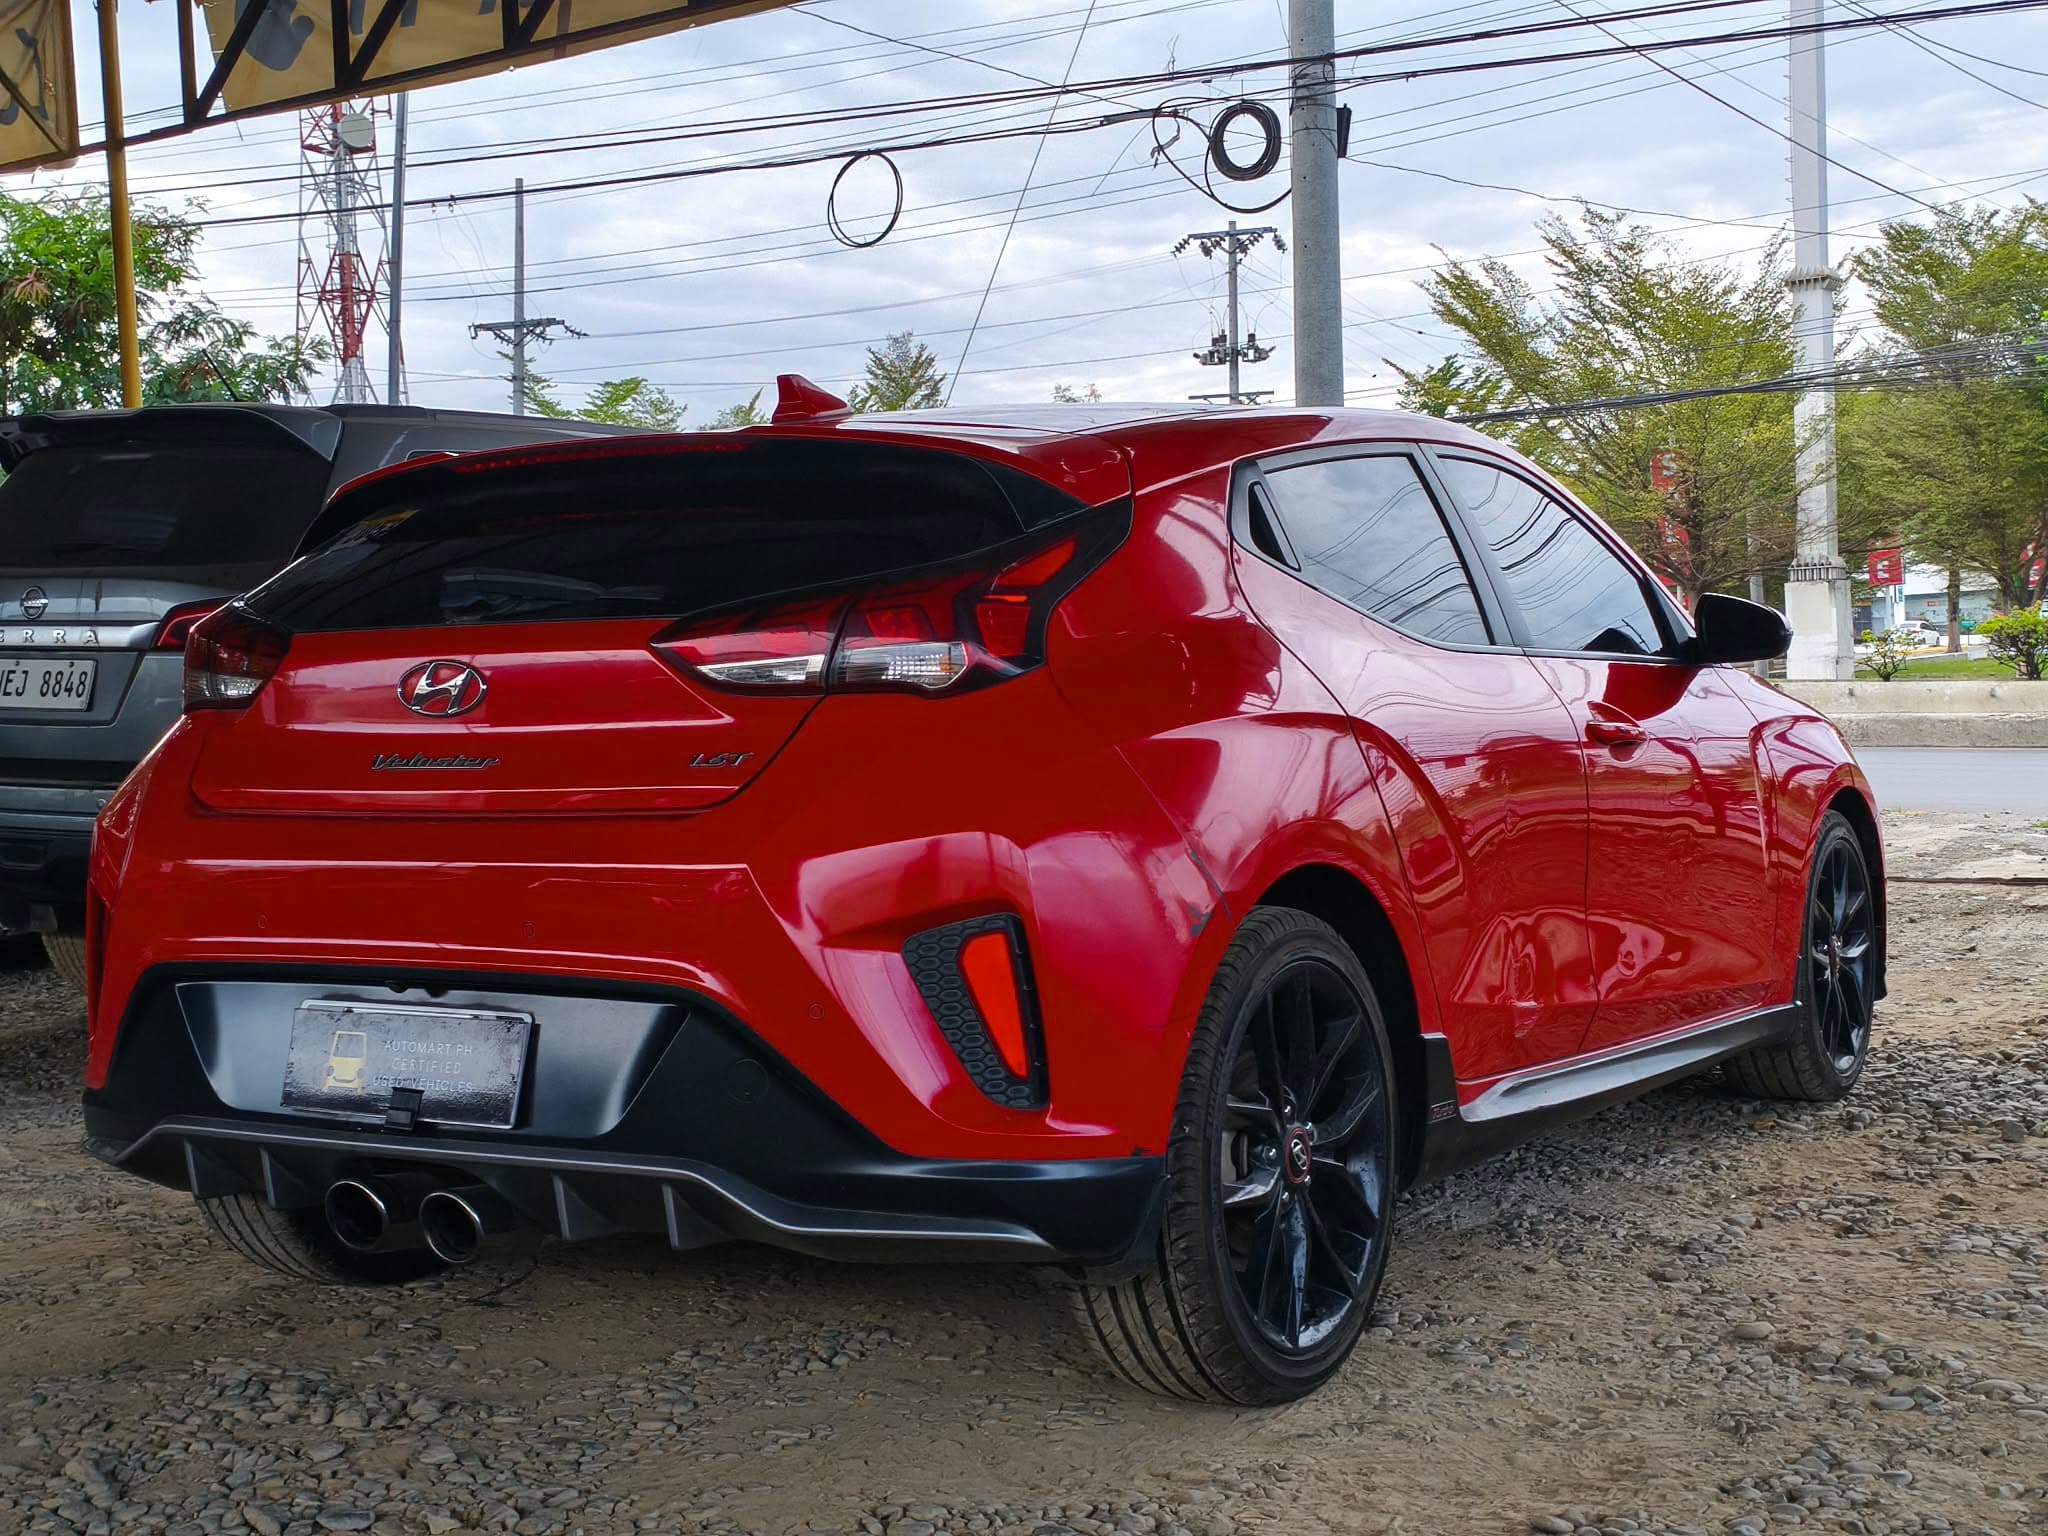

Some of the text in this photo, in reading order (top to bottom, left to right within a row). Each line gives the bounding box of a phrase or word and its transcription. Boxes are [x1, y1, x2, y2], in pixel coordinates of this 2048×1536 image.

[39, 670, 89, 698] 8848
[371, 752, 501, 771] Veloster
[384, 1040, 473, 1056] AUTOMART PH
[392, 1057, 461, 1074] CERTIFIED
[372, 1075, 473, 1093] USED VEHICLES
